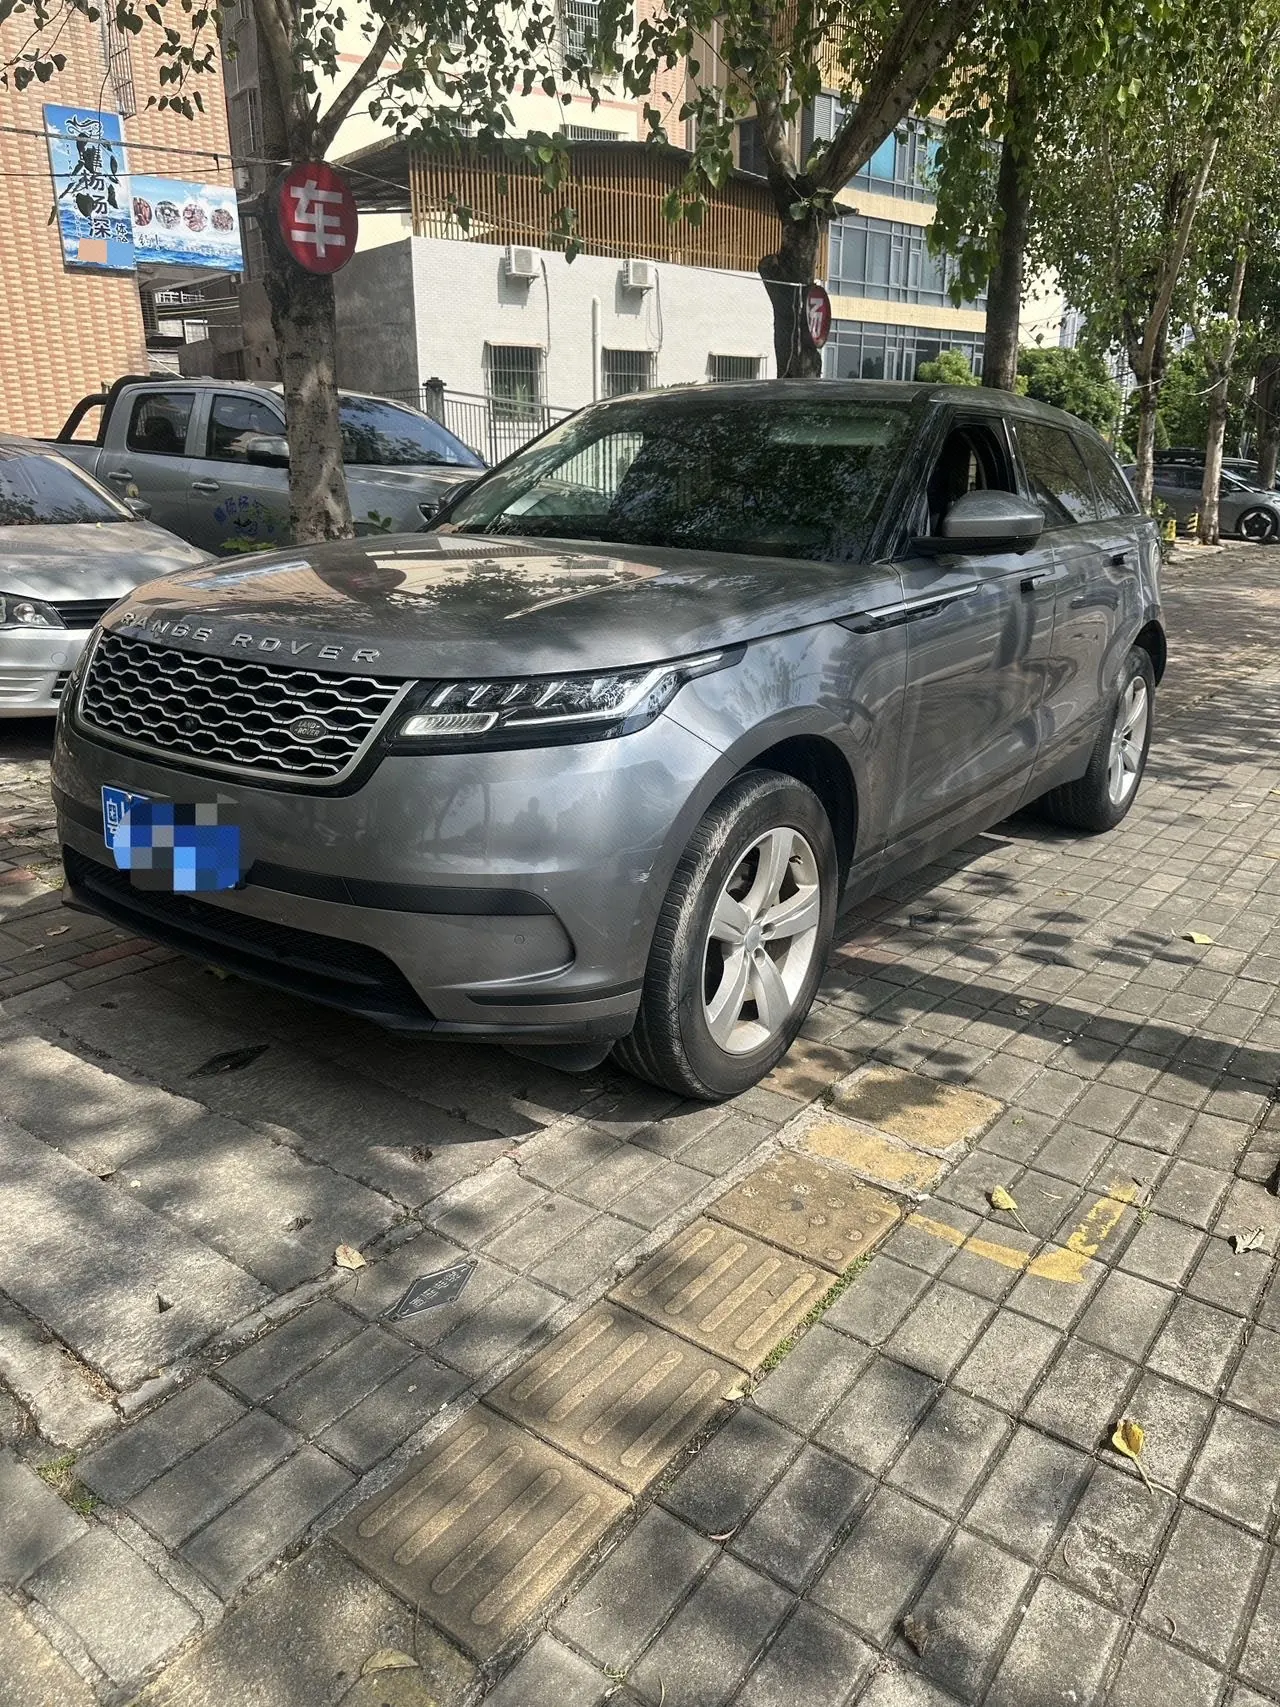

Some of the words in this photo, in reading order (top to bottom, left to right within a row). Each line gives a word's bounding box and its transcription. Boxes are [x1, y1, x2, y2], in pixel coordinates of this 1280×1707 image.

[290, 180, 346, 258] 车
[120, 612, 213, 642] RANGE
[231, 632, 382, 664] ROVER
